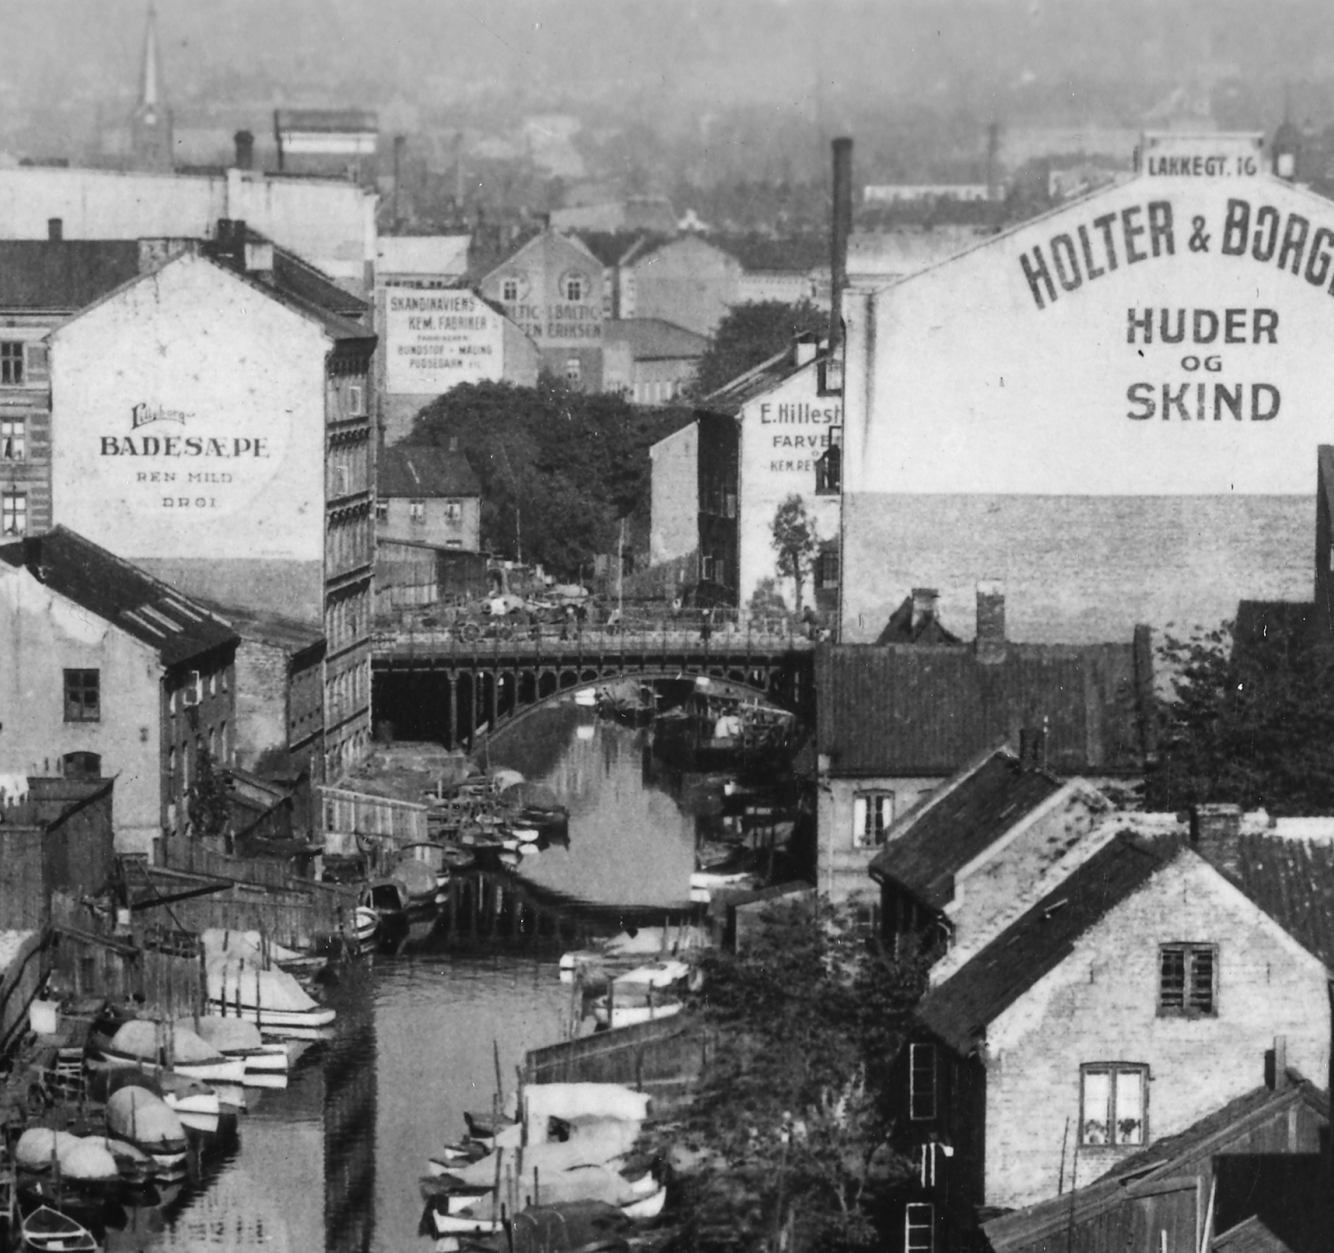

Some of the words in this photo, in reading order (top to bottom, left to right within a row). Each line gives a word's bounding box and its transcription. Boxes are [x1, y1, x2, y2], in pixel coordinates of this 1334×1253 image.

[1148, 156, 1231, 176] LAKKEGT.
[1019, 200, 1176, 310] HOLTER
[1188, 215, 1211, 253] &
[1127, 308, 1279, 344] HUDER
[1180, 355, 1222, 372] OG
[1126, 383, 1280, 421] SKIND
[100, 436, 270, 458] BADESÆPE
[136, 471, 176, 482] REN
[188, 472, 233, 483] MILD
